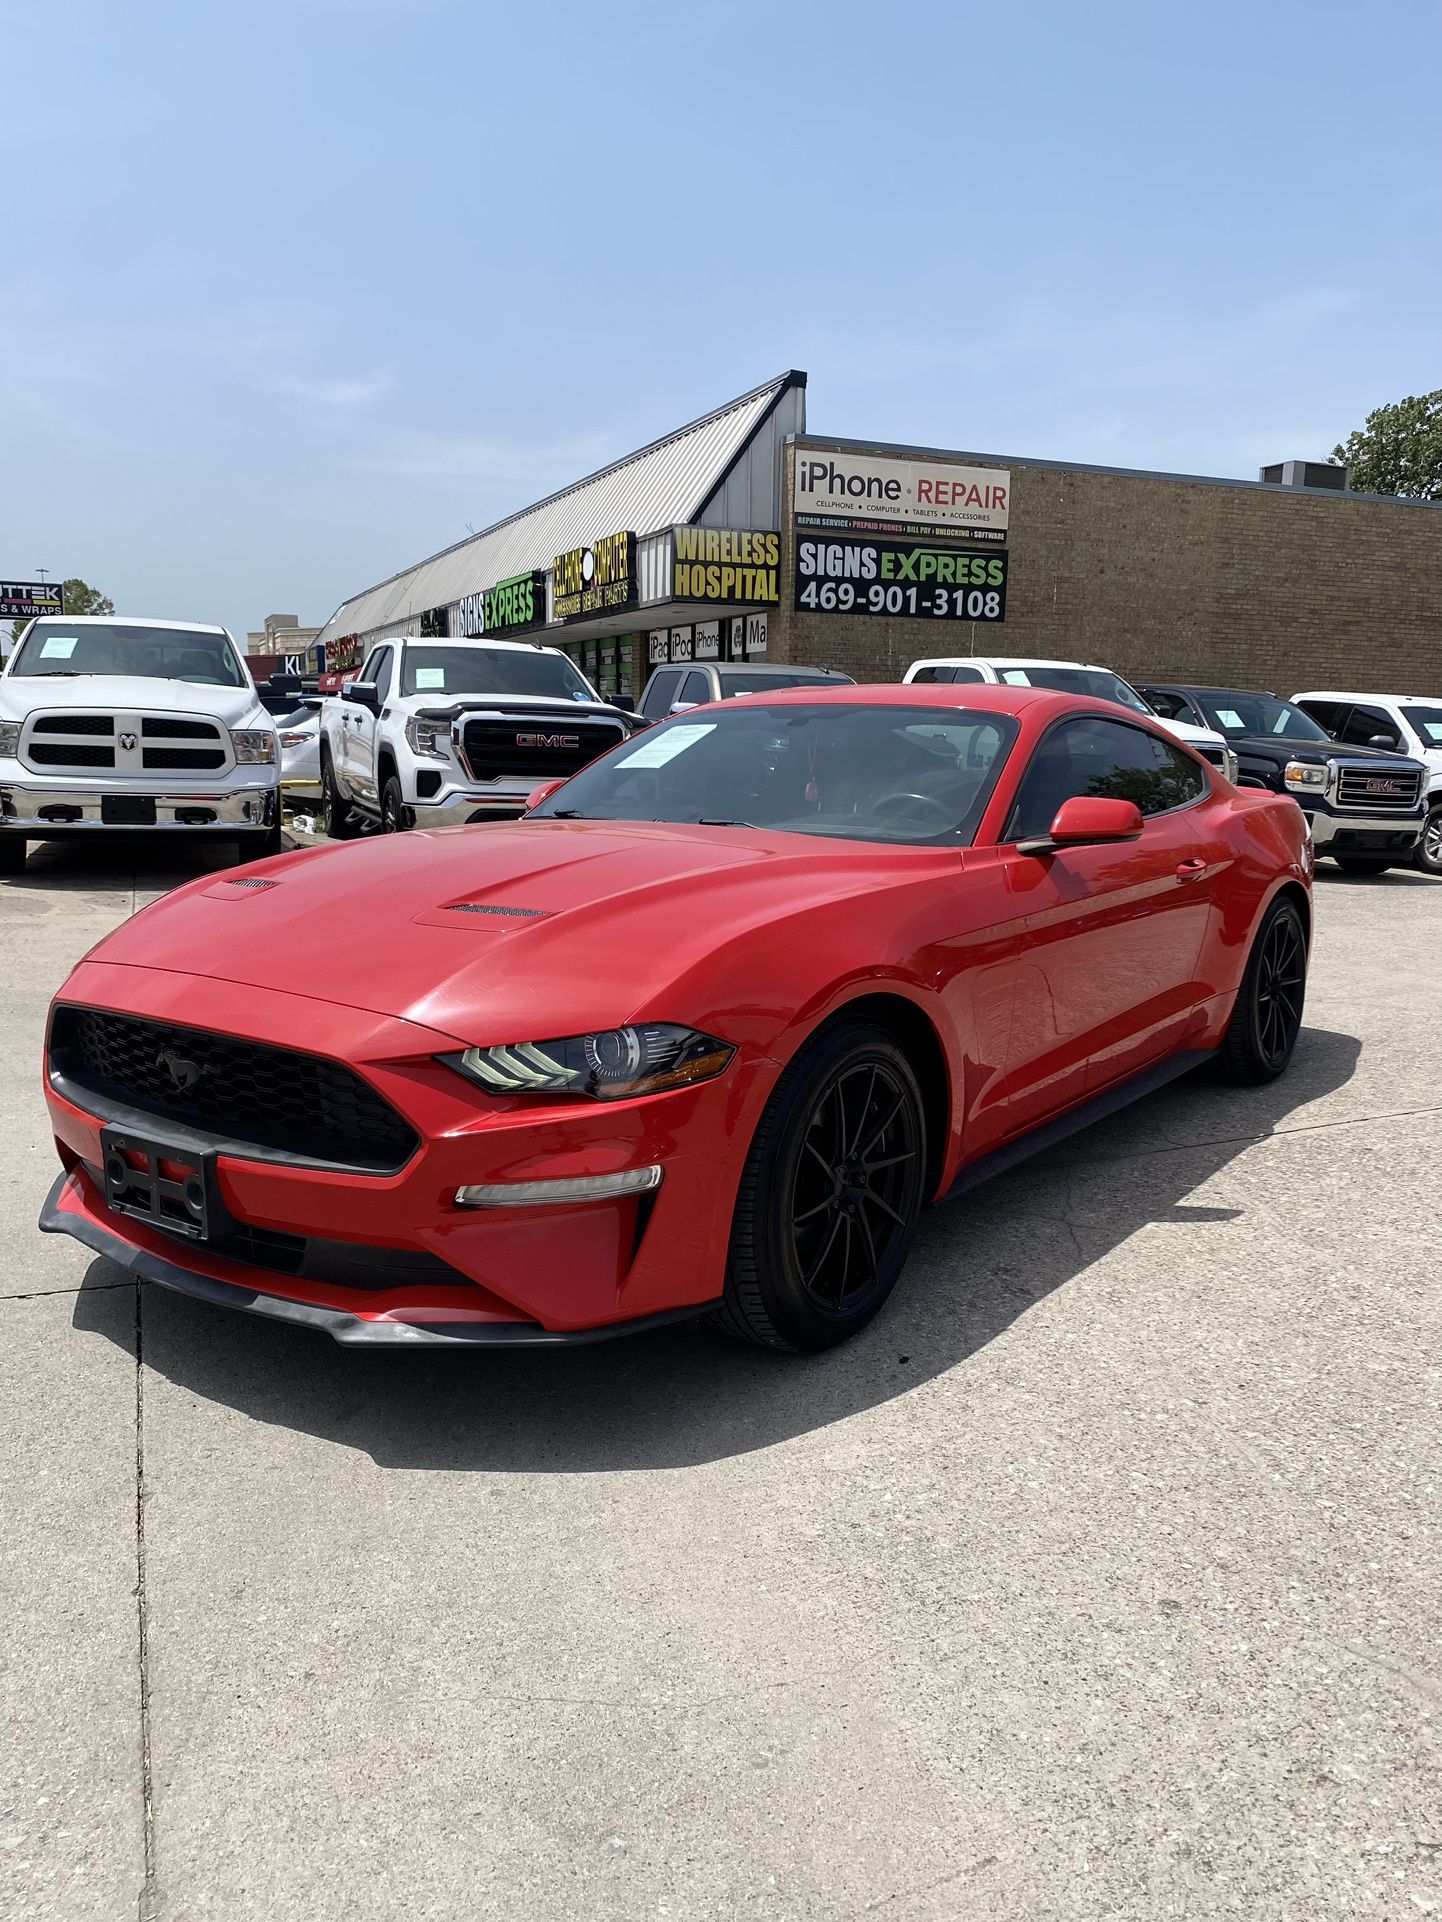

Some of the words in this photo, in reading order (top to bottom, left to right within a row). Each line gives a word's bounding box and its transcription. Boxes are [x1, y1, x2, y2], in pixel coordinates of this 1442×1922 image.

[801, 461, 901, 500] iPhone
[917, 479, 1007, 510] REPAIR
[816, 500, 854, 510] CELLPHONE
[866, 505, 901, 514] COMPUTER
[913, 509, 937, 517] TABLETS
[950, 512, 990, 521] ACCESSORIES
[797, 516, 820, 525] REPAIR
[821, 518, 848, 527] SERVICE
[852, 520, 878, 530] PREPAID
[879, 522, 902, 532] PHONES
[907, 525, 919, 534] BILL
[920, 526, 931, 534] PAY
[935, 528, 969, 537] UNLOCKING
[974, 530, 1005, 540] SOFTWARE
[594, 530, 628, 586] COMPUTER
[675, 527, 779, 566] WIRELESS
[800, 542, 877, 579] SIGNS
[880, 548, 1004, 586] EXPRESS
[0, 585, 60, 600] TTEK
[604, 580, 629, 606] PARTS
[675, 563, 779, 601] HOSPITAL
[21, 605, 62, 615] WRAPS
[459, 592, 485, 637] SIGNS
[484, 571, 534, 629] EXPRESS
[800, 581, 1000, 618] 469-901-3108
[696, 630, 719, 649] iPhone
[516, 733, 579, 748] GMC
[1366, 779, 1402, 792] GMC
